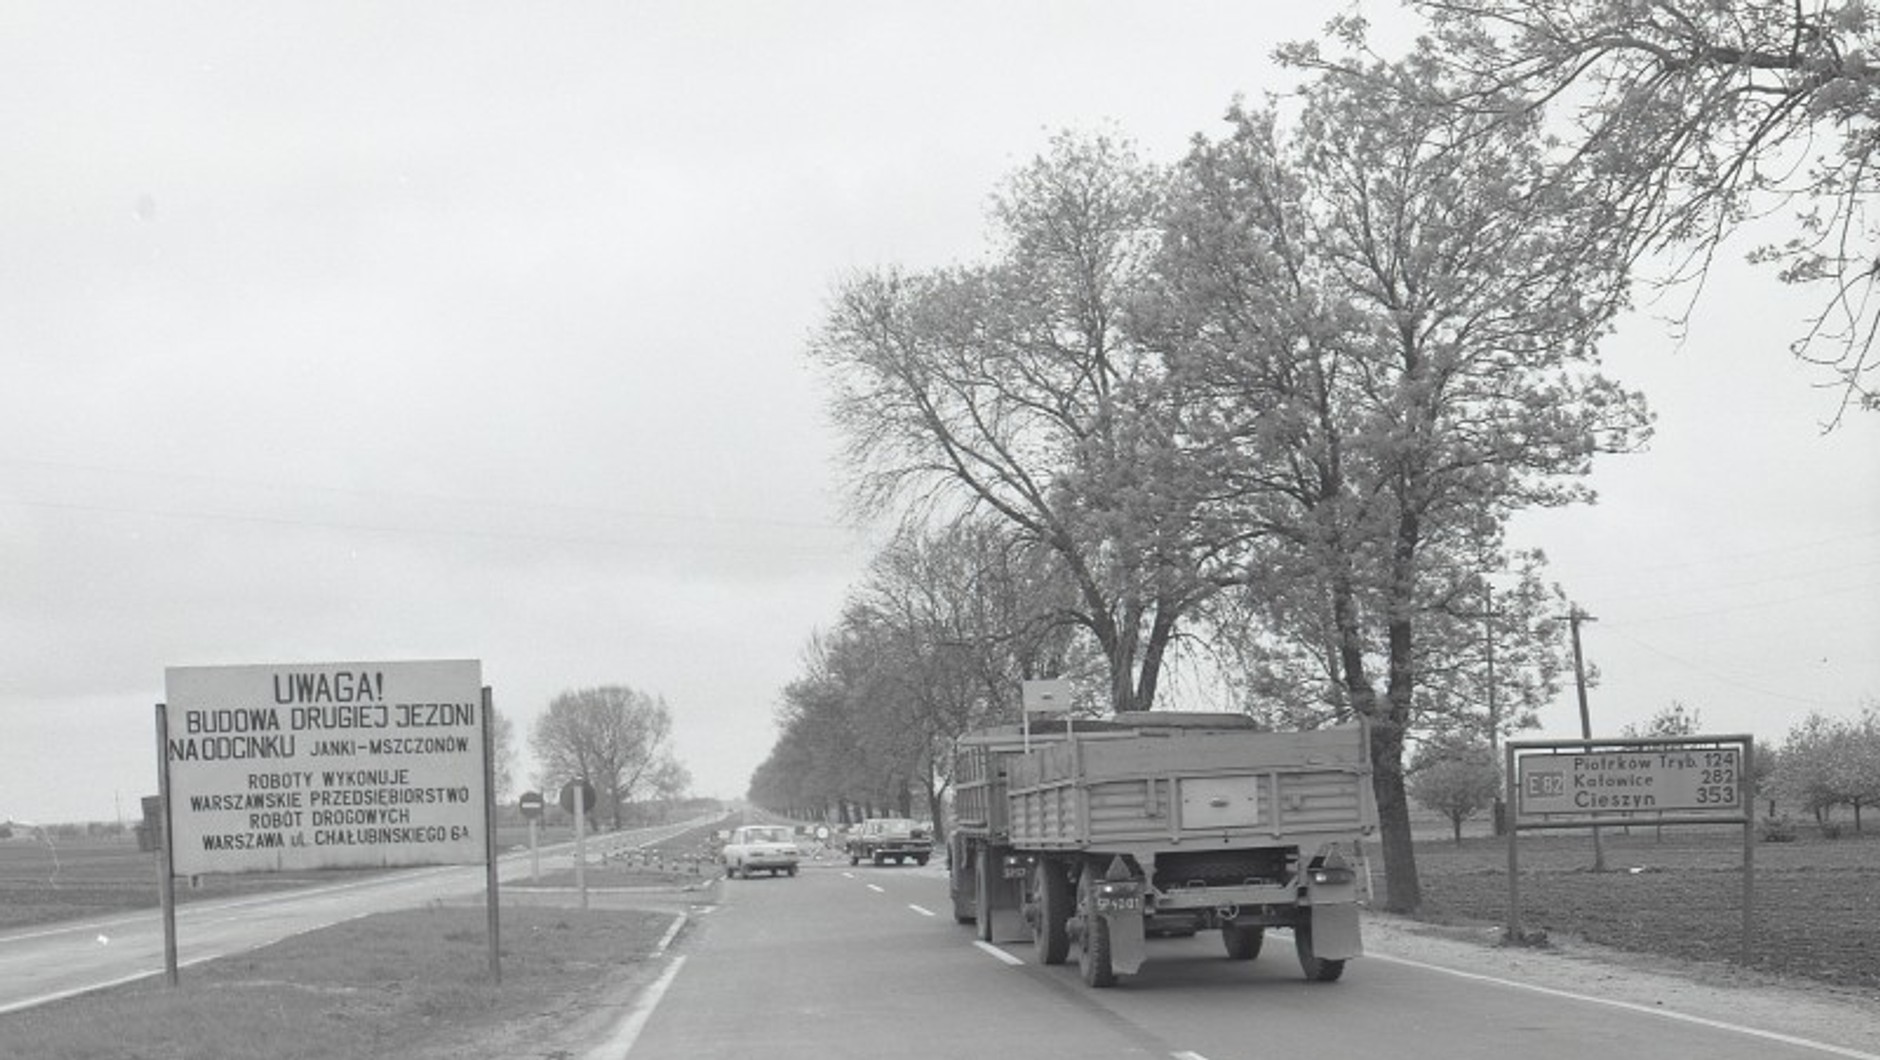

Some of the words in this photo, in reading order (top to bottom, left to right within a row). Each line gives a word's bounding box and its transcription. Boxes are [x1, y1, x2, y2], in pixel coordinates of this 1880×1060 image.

[274, 672, 384, 704] UWAGA!
[186, 708, 280, 734] BUDOWA
[291, 705, 388, 730] DRUGIEJ
[395, 703, 475, 728] JEZDNI
[202, 735, 295, 760] ODCINKU
[1660, 754, 1698, 770] Tryb.
[1704, 752, 1734, 768] 124
[248, 771, 314, 789] ROBOTY
[322, 769, 410, 787] WYKONUJE
[1574, 773, 1653, 787] Katowice
[1701, 769, 1733, 784] 282
[190, 792, 302, 812] WARSZAWSKIE
[1574, 790, 1656, 808] Cieszyn
[1696, 786, 1734, 804] 353
[312, 809, 410, 827] DROGOWYCH
[202, 832, 285, 851] WARSZAWA
